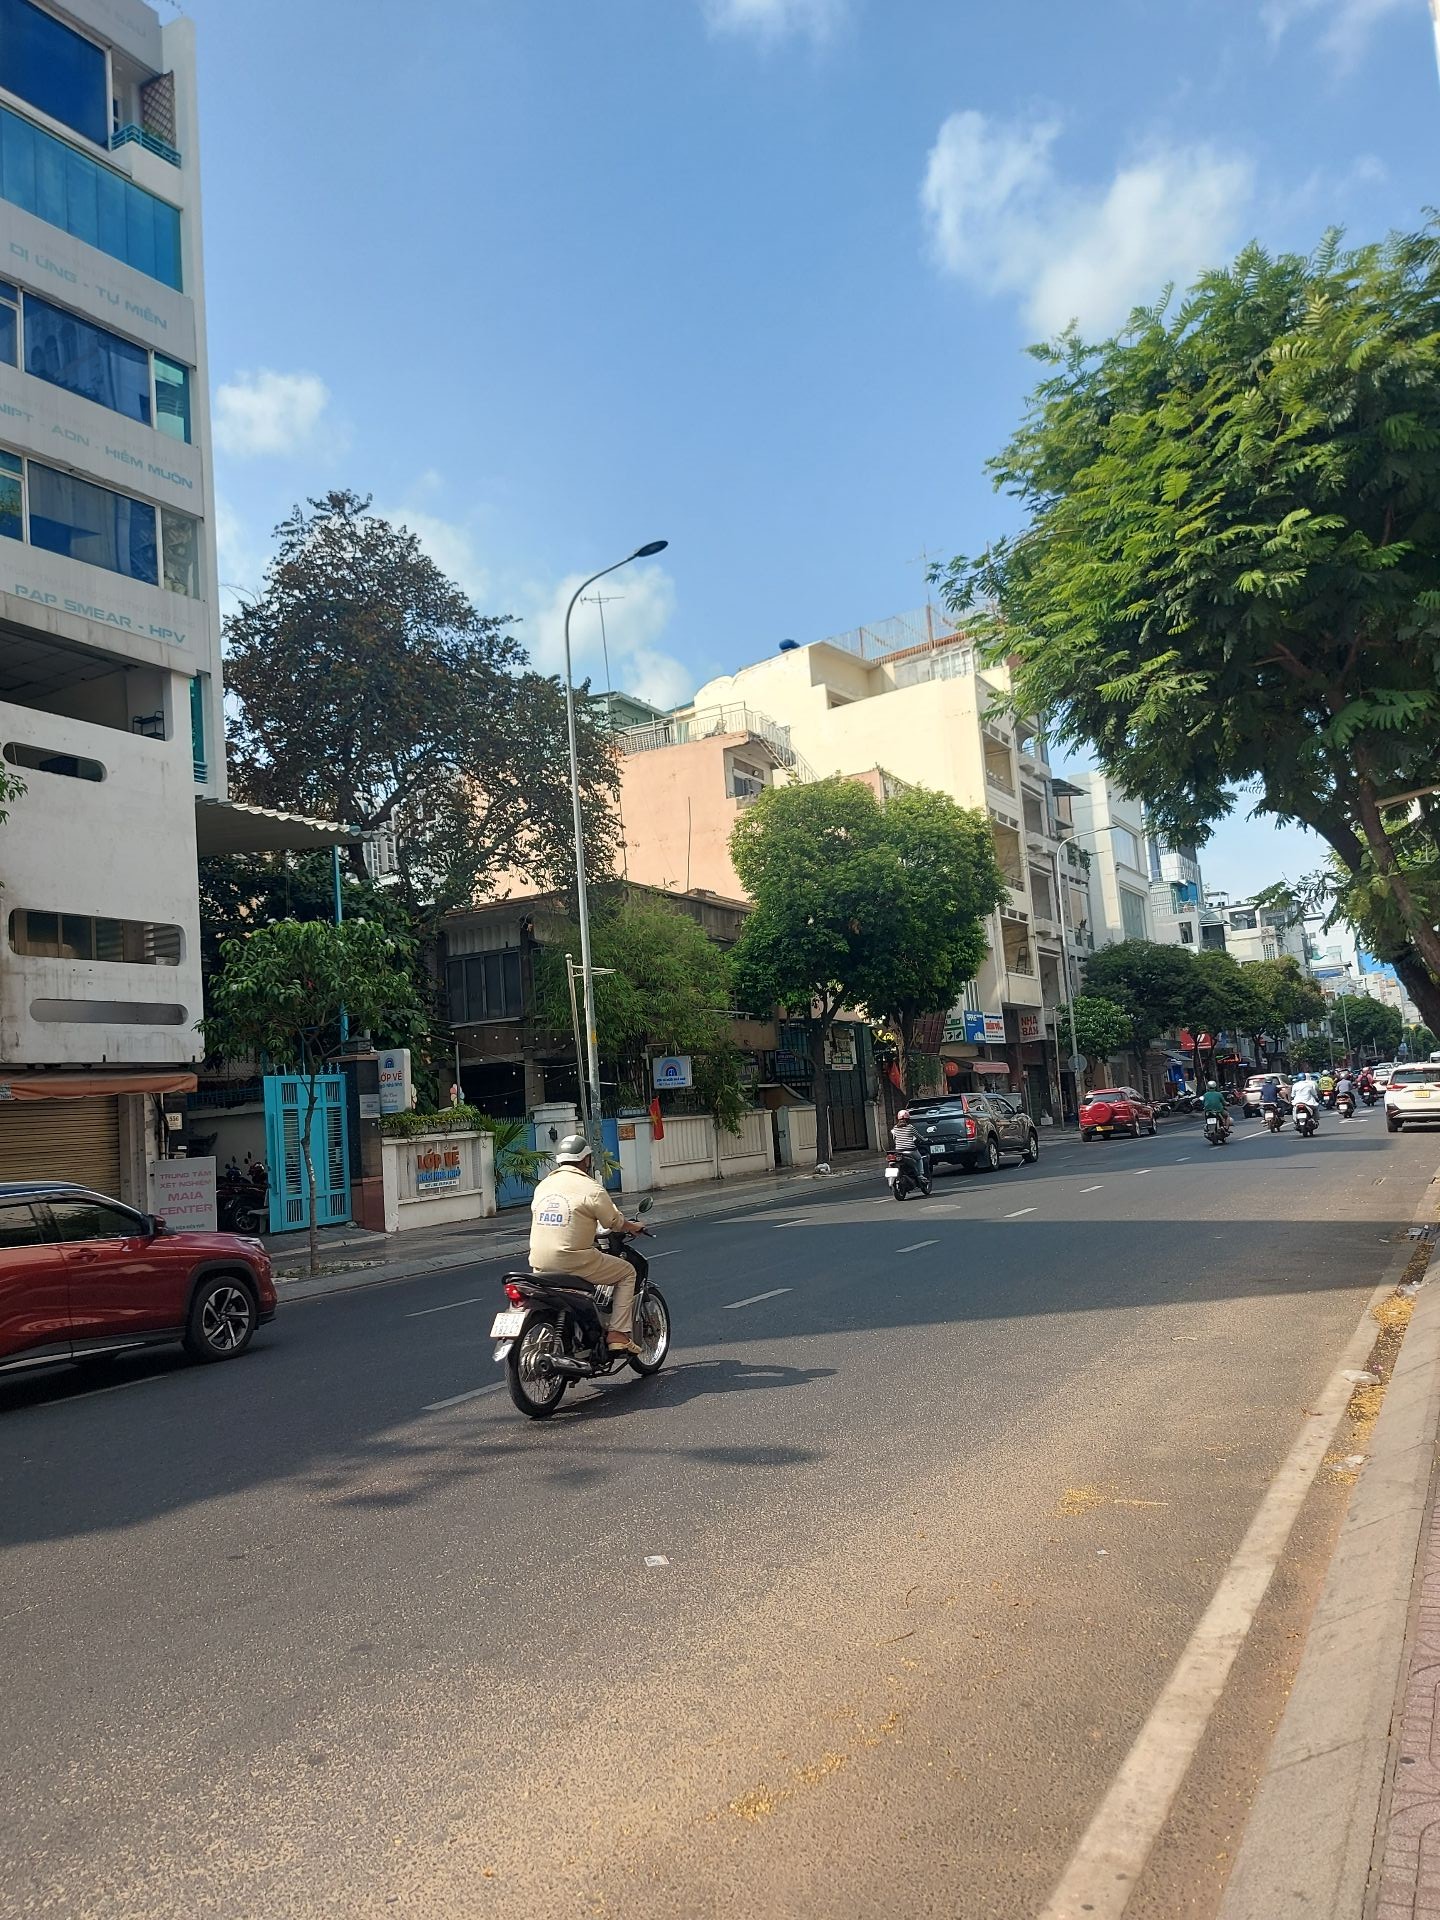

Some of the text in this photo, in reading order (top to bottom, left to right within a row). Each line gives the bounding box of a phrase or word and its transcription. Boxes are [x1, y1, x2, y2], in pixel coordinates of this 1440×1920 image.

[15, 584, 57, 603] PAP
[64, 598, 132, 628] SMEAR
[149, 624, 186, 643] HPV
[417, 1148, 442, 1170] LỚP
[160, 1172, 190, 1180] TRUNG
[168, 1191, 204, 1202] MAIA
[159, 1204, 213, 1216] CENTER
[539, 1212, 563, 1223] FACO
